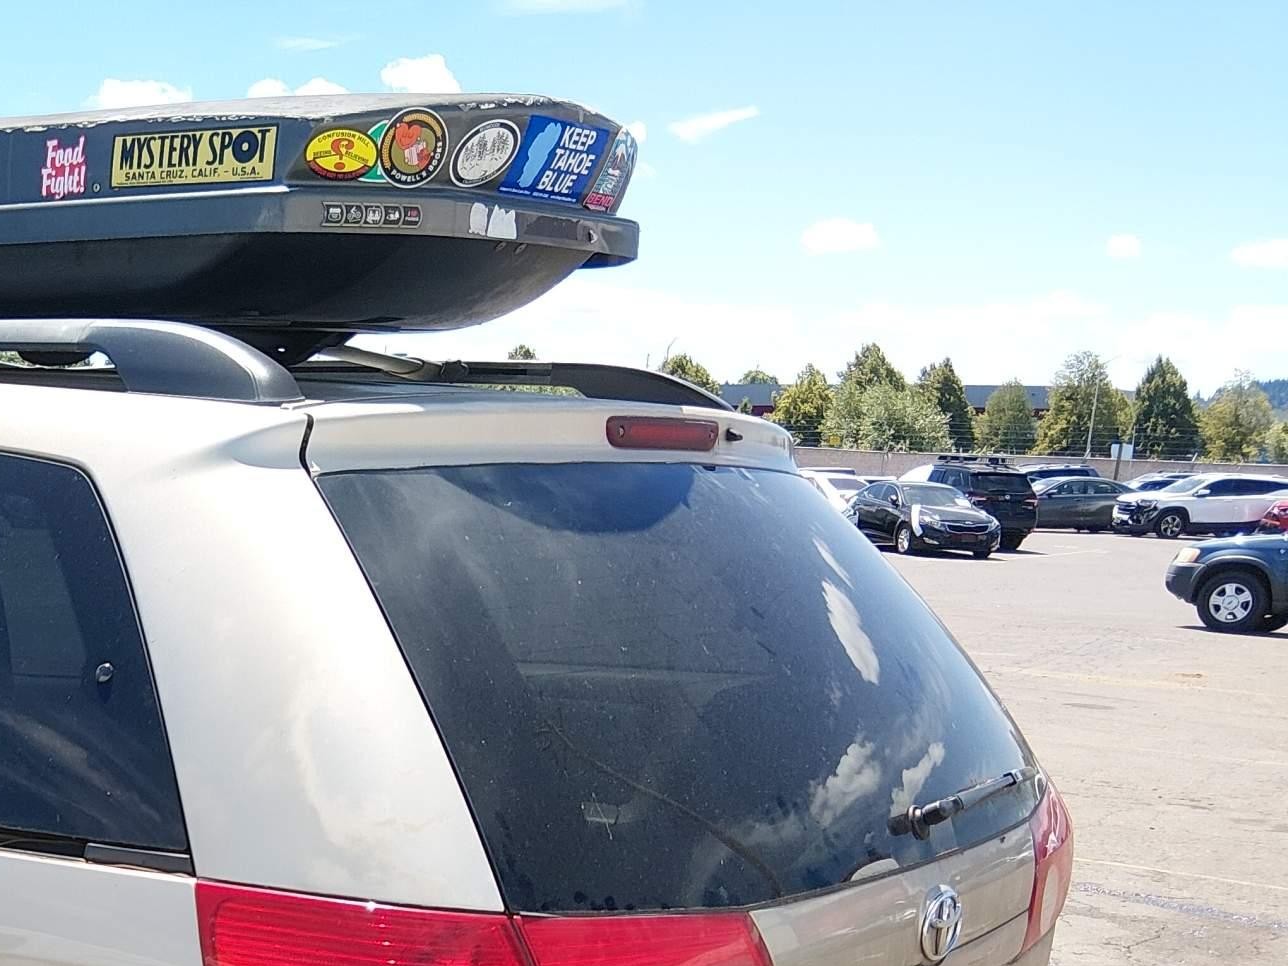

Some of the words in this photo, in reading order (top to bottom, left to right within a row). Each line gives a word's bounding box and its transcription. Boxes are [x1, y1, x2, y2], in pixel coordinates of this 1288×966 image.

[119, 133, 204, 170] MYSTERY
[206, 129, 272, 166] SPOT
[317, 131, 356, 143] CONFUSION
[560, 125, 597, 152] KEEP
[46, 135, 85, 168] Food
[550, 149, 596, 175] TAHOE
[42, 165, 86, 199] Fight!
[124, 170, 156, 182] SANTA
[191, 167, 221, 178] CALIF.
[232, 166, 260, 177] U.S.A.
[587, 193, 614, 208] BEND
